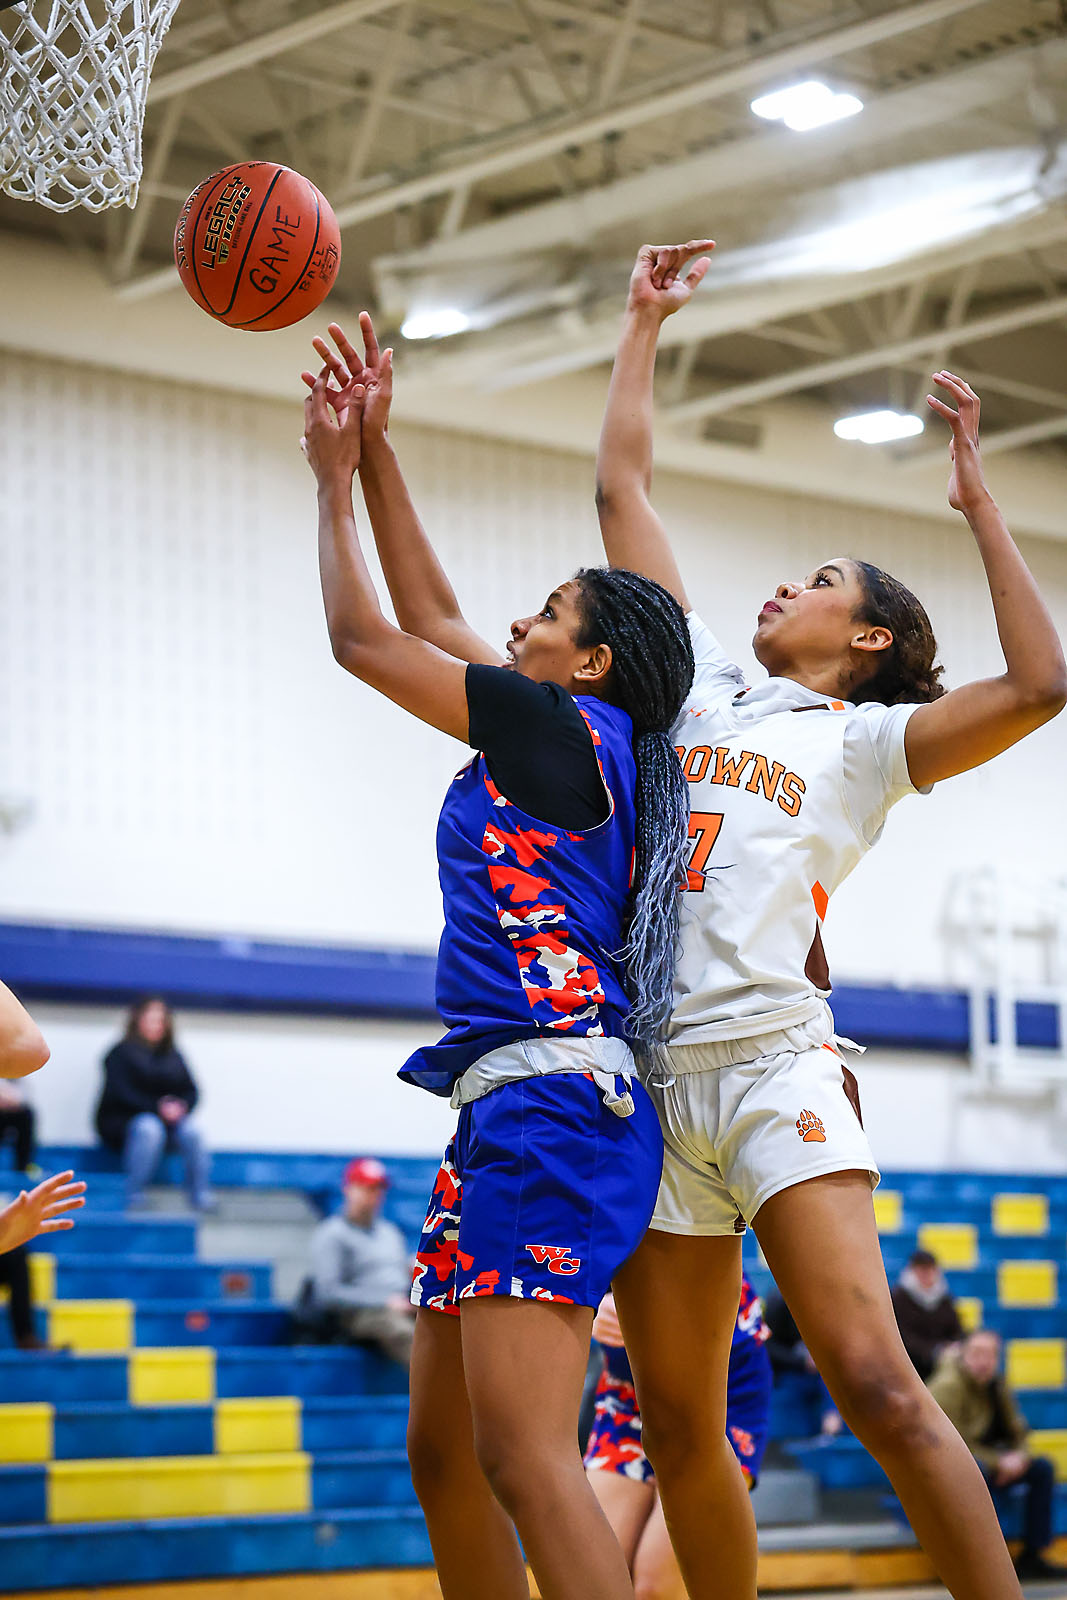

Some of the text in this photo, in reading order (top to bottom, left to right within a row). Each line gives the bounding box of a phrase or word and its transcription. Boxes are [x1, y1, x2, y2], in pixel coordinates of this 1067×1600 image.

[202, 176, 244, 270] LEGACY
[222, 185, 252, 242] 1000
[250, 205, 300, 293] GAME
[299, 247, 325, 291] BALL
[525, 1244, 581, 1276] WC
